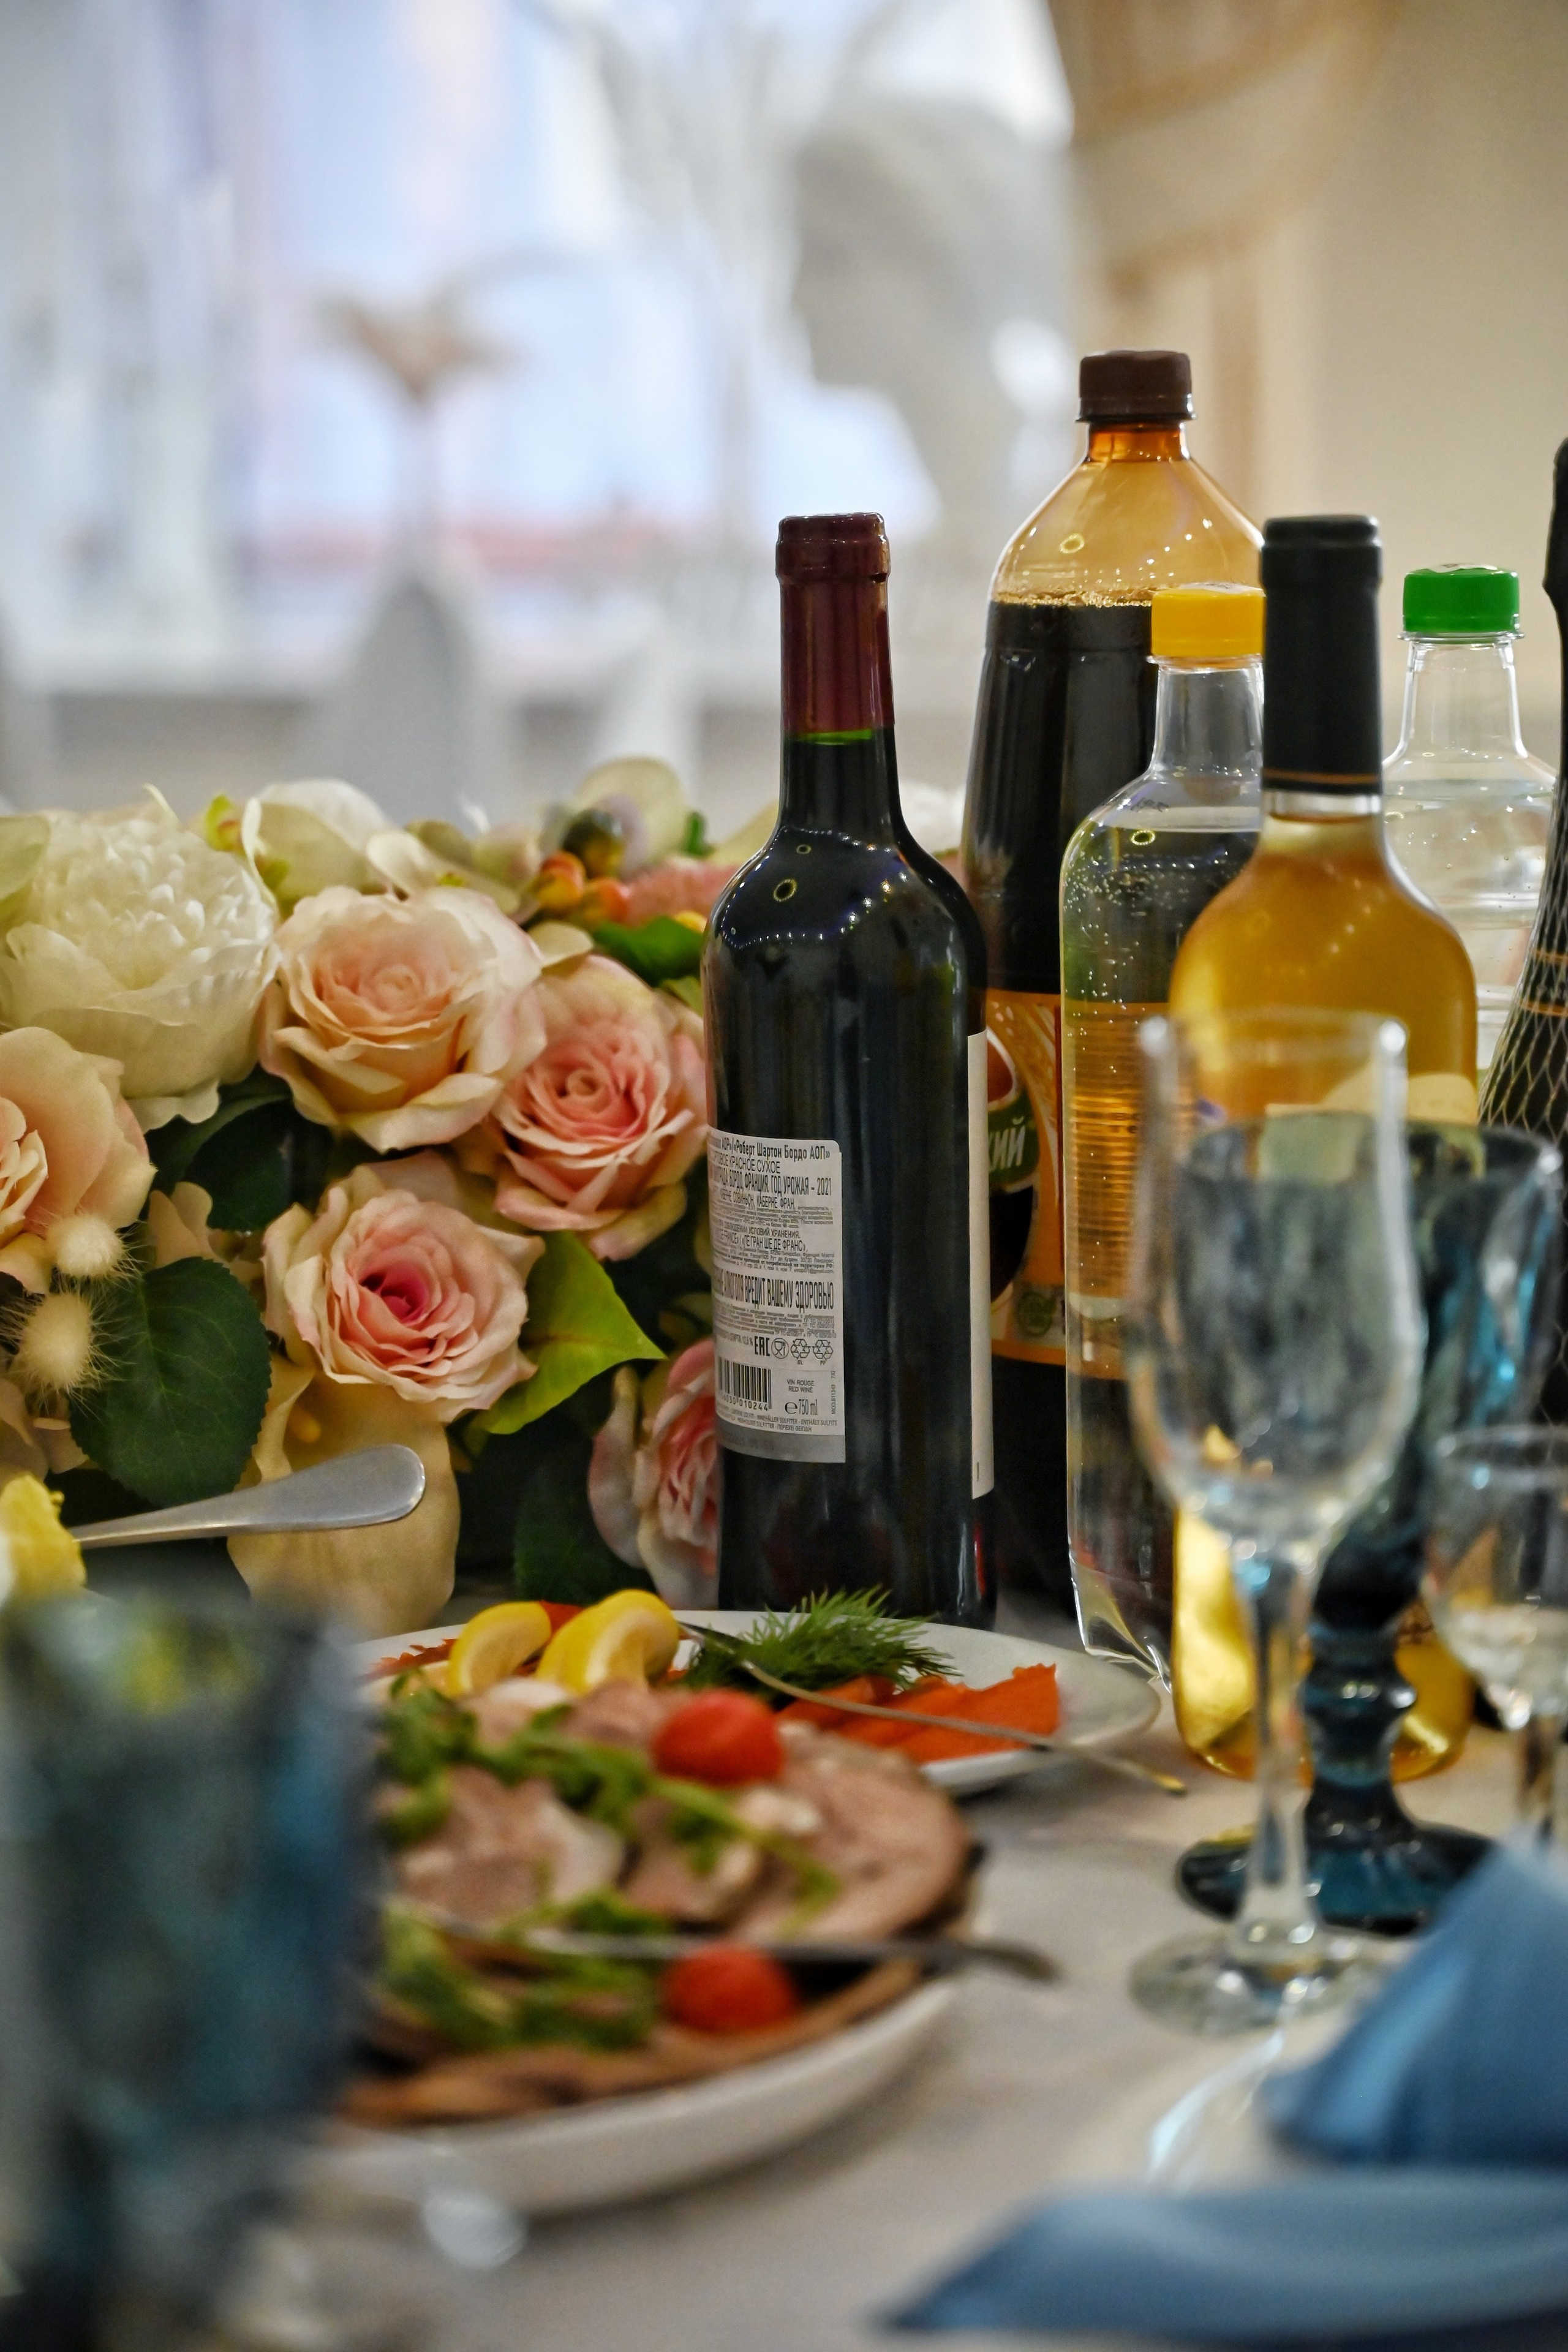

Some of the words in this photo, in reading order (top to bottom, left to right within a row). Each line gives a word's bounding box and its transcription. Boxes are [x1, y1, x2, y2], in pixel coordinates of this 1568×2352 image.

[756, 1142, 782, 1161] Шартон
[784, 1144, 807, 1162] Бордо
[809, 1145, 831, 1159] АОП»
[757, 1159, 781, 1174] СУХОЕ
[771, 1175, 782, 1197] ГОД
[783, 1176, 809, 1195] УРОЖАЯ
[816, 1177, 832, 1196] 2021
[756, 1195, 778, 1208] КАБЕРНЕ
[750, 1235, 763, 1248] ГРАН
[764, 1238, 772, 1250] ШЕ
[774, 1238, 782, 1251] ДЕ
[745, 1275, 766, 1310] ВРЕДИТ
[767, 1278, 794, 1308] ВАШЕМУ
[796, 1280, 834, 1313] ЗДОРОВЬЮ
[798, 1398, 809, 1415] 750
[810, 1398, 818, 1415] ml
